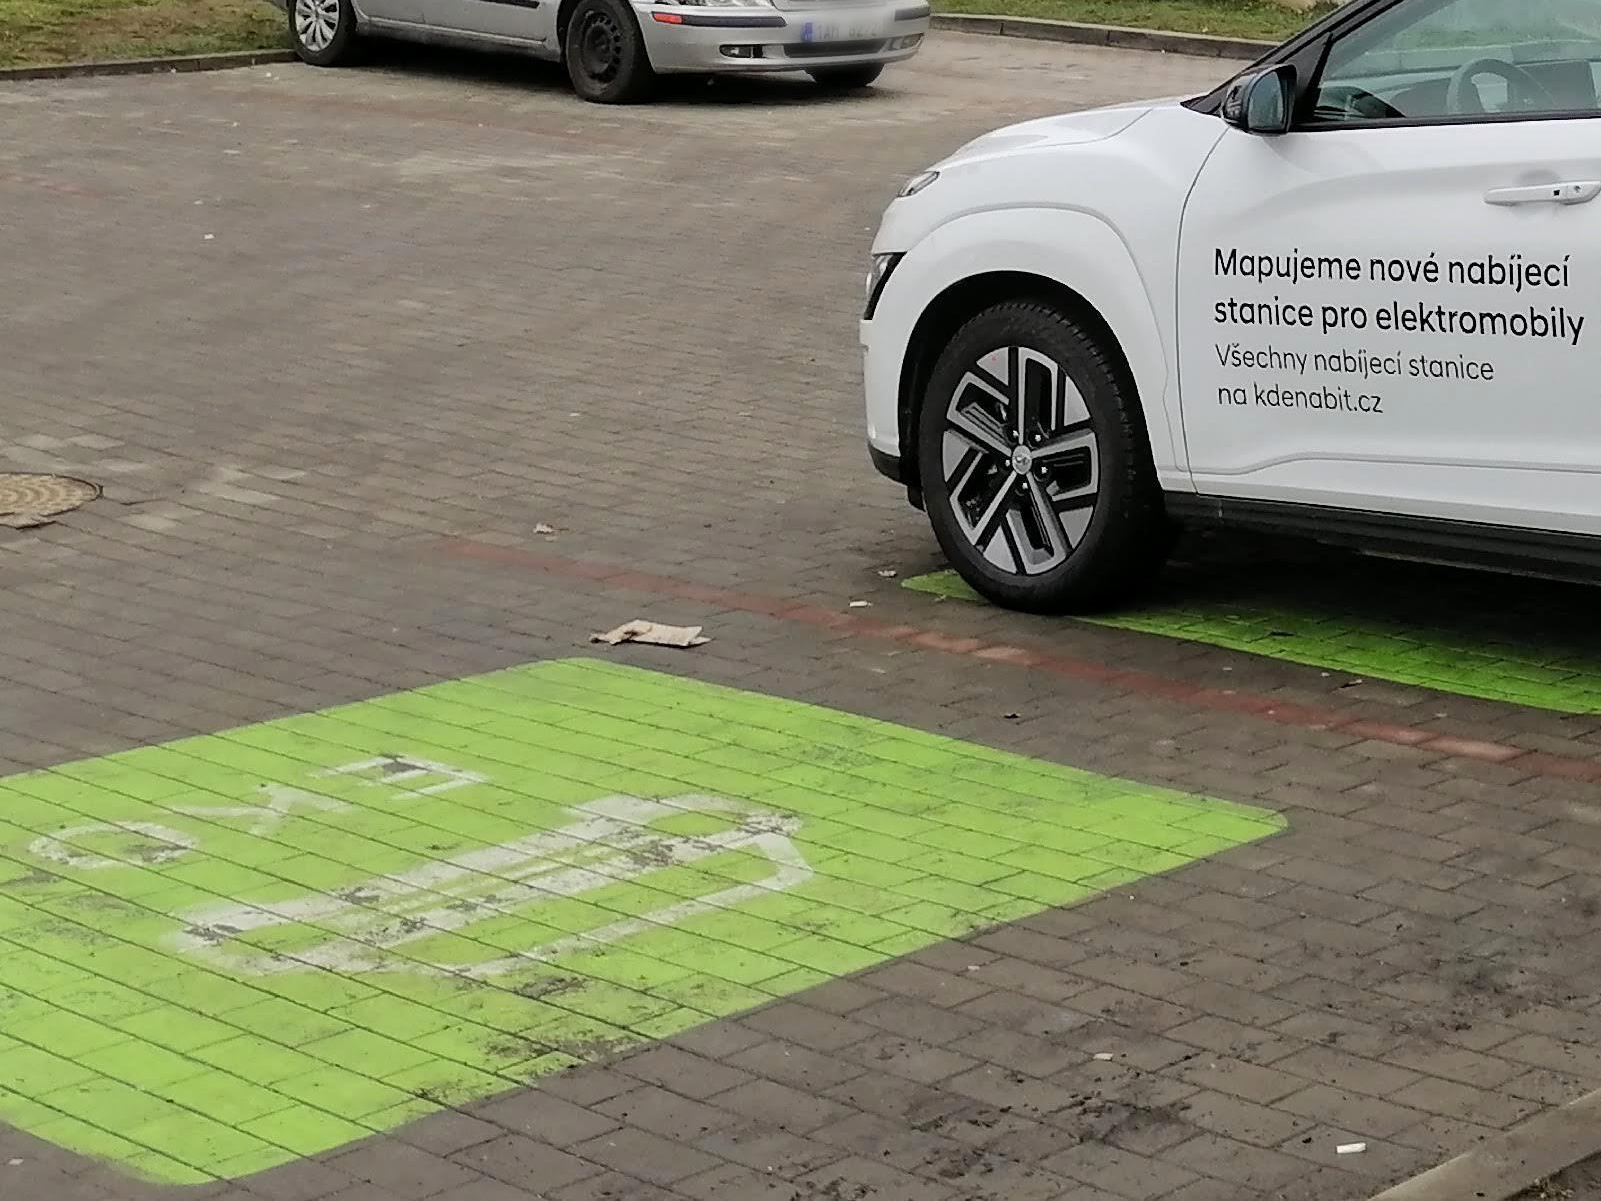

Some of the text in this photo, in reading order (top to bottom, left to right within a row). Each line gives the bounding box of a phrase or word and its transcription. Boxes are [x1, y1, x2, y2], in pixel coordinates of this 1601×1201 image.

[1214, 248, 1571, 293] Mapujeme nové nabíjecí
[1214, 296, 1584, 346] stanice pro elektromobily
[1215, 344, 1308, 375] Všechny
[1408, 354, 1494, 381] stanice
[1217, 382, 1383, 414] na kdenabit.cz
